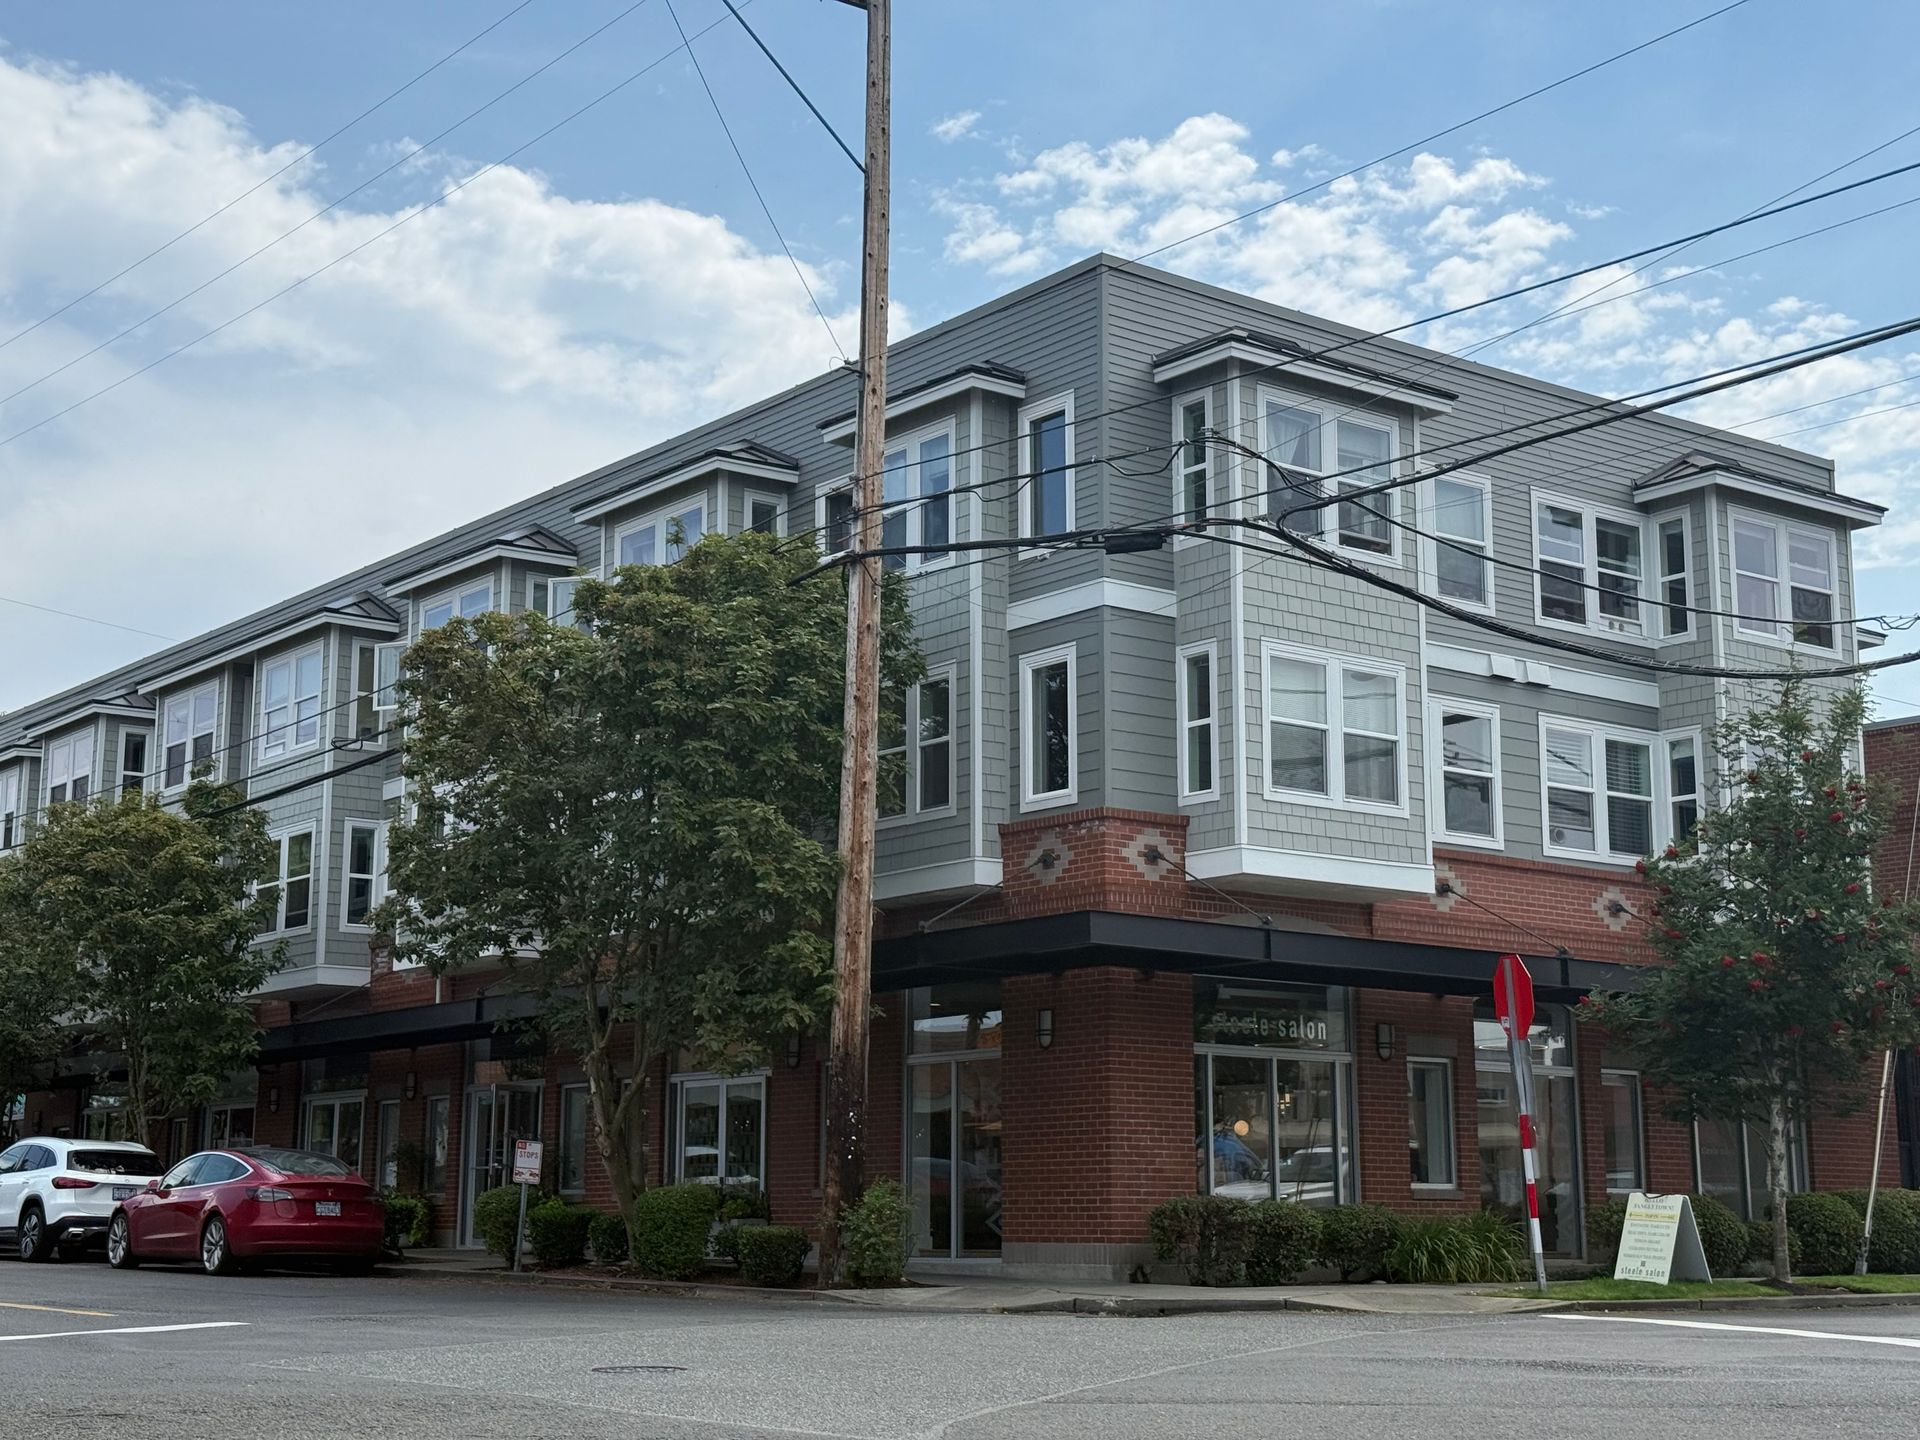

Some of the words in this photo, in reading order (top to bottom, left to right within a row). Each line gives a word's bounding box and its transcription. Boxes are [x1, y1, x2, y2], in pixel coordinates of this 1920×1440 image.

[1278, 1014, 1327, 1040] salon
[519, 1151, 539, 1159] STOPS
[1620, 1266, 1642, 1275] steele
[1645, 1267, 1665, 1277] salon
